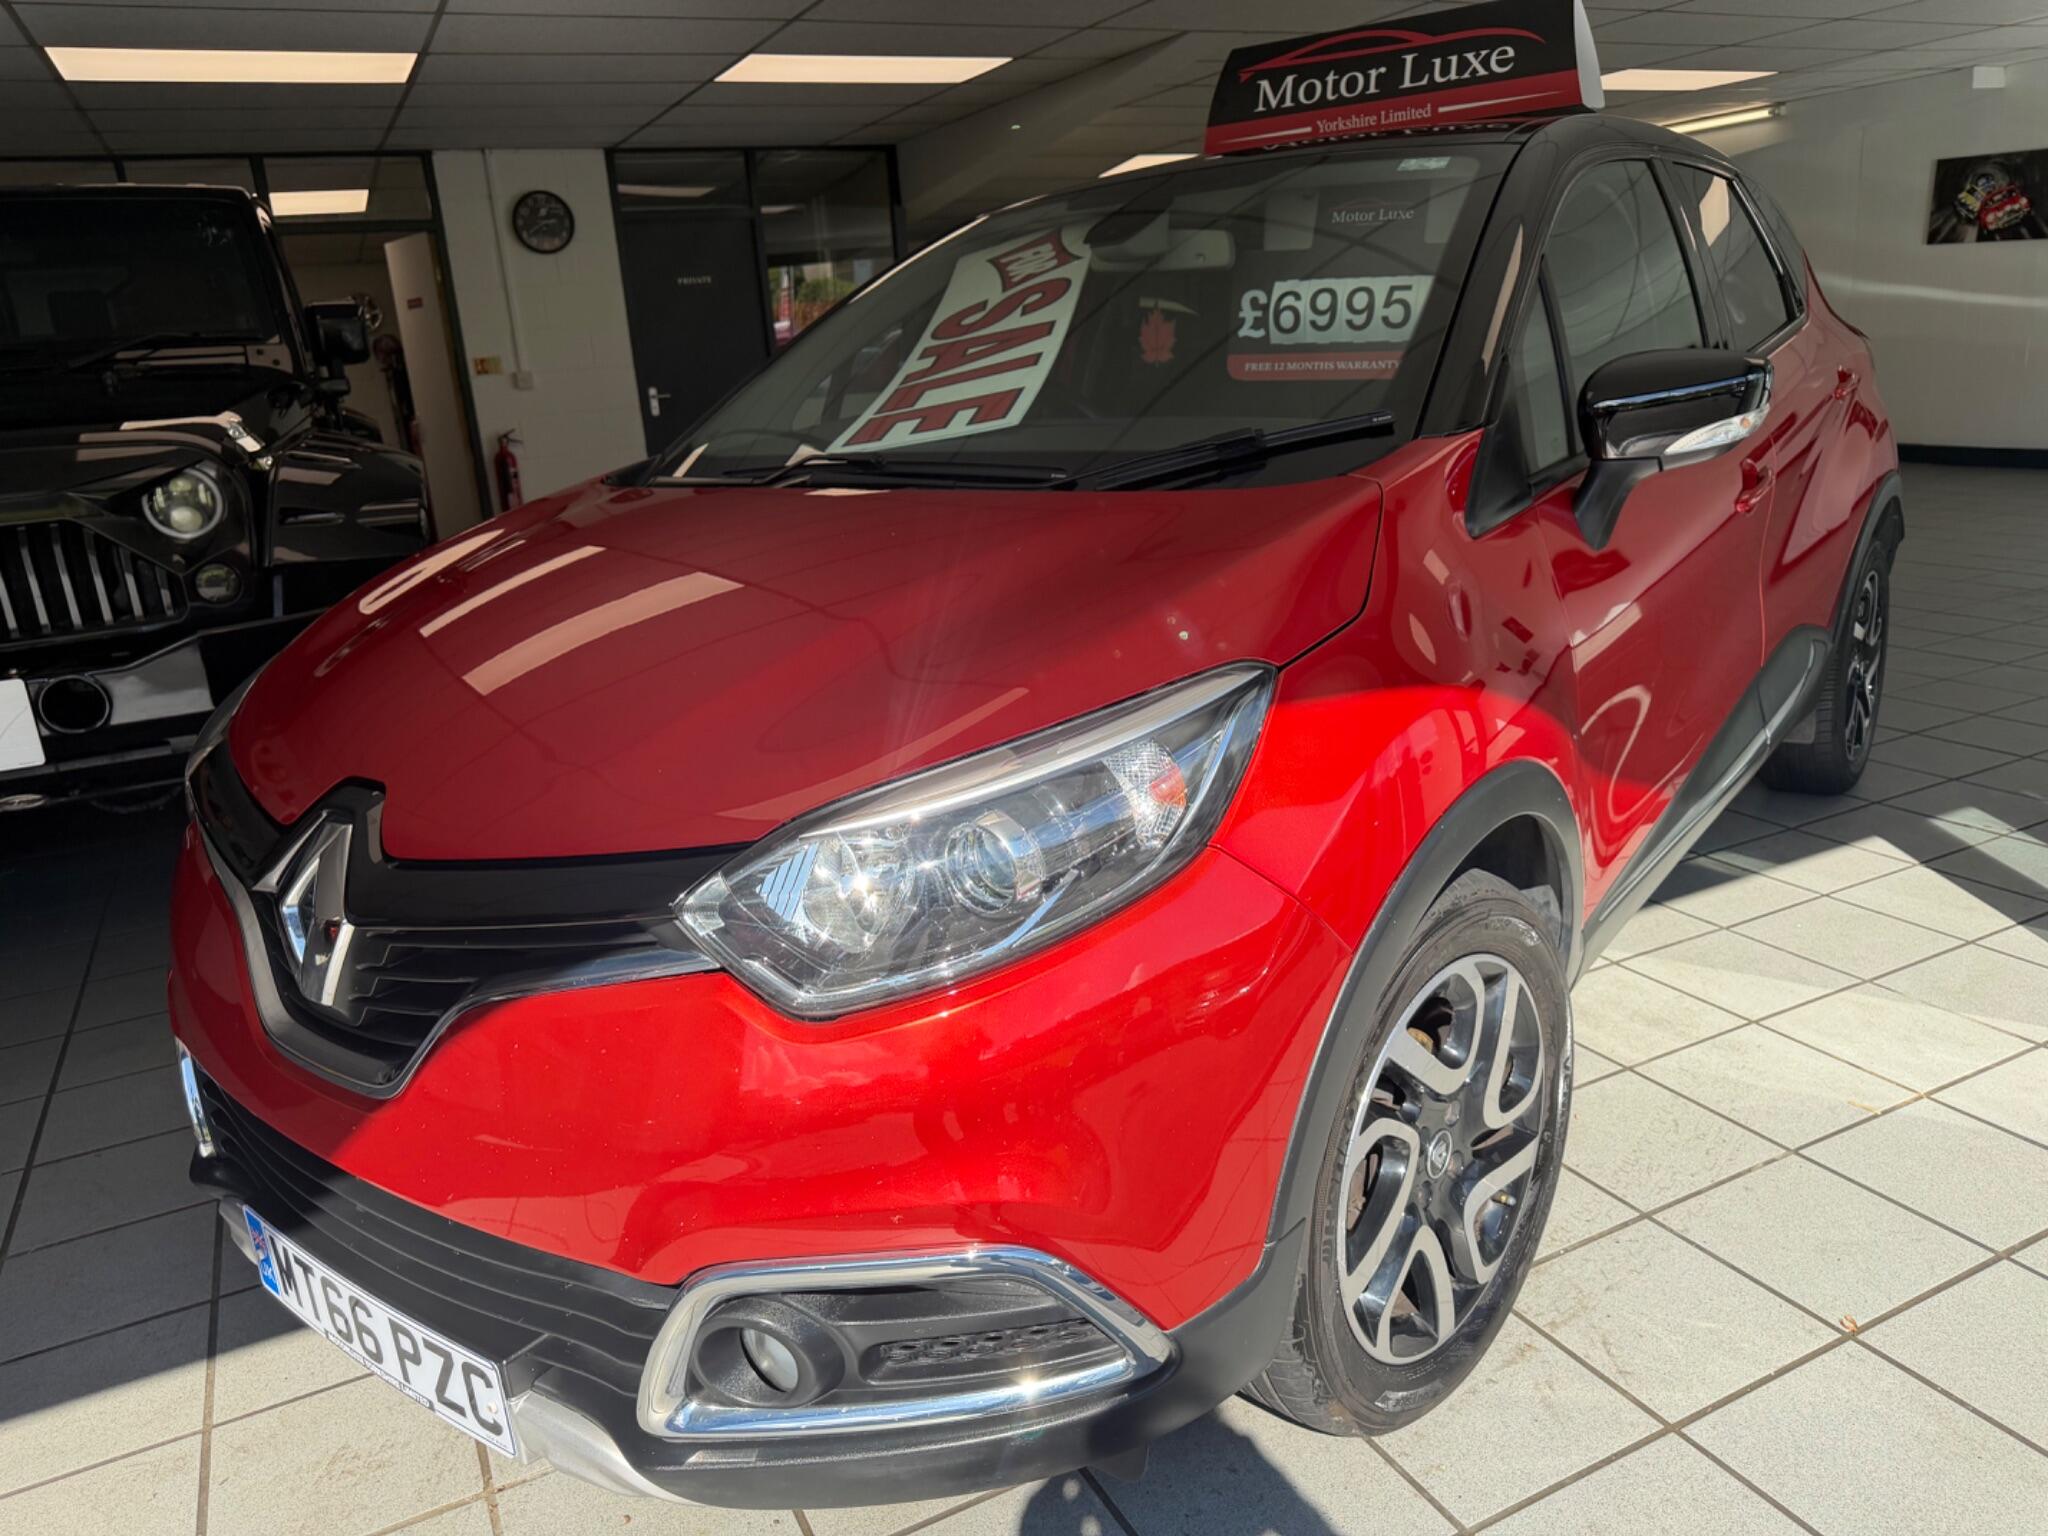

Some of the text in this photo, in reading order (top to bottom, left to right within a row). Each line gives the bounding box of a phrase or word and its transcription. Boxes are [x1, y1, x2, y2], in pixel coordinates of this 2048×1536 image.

[1254, 44, 1516, 112] Motor Luxe
[1316, 103, 1432, 133] Yorkshire Limited
[1331, 208, 1415, 224] Motor Luxe
[1237, 284, 1414, 339] £6995
[841, 276, 1072, 447] SALE
[1244, 359, 1401, 372] FREE 12 MONTHS WARRANTY
[268, 1235, 384, 1366] MT66
[388, 1316, 504, 1437] PZC
